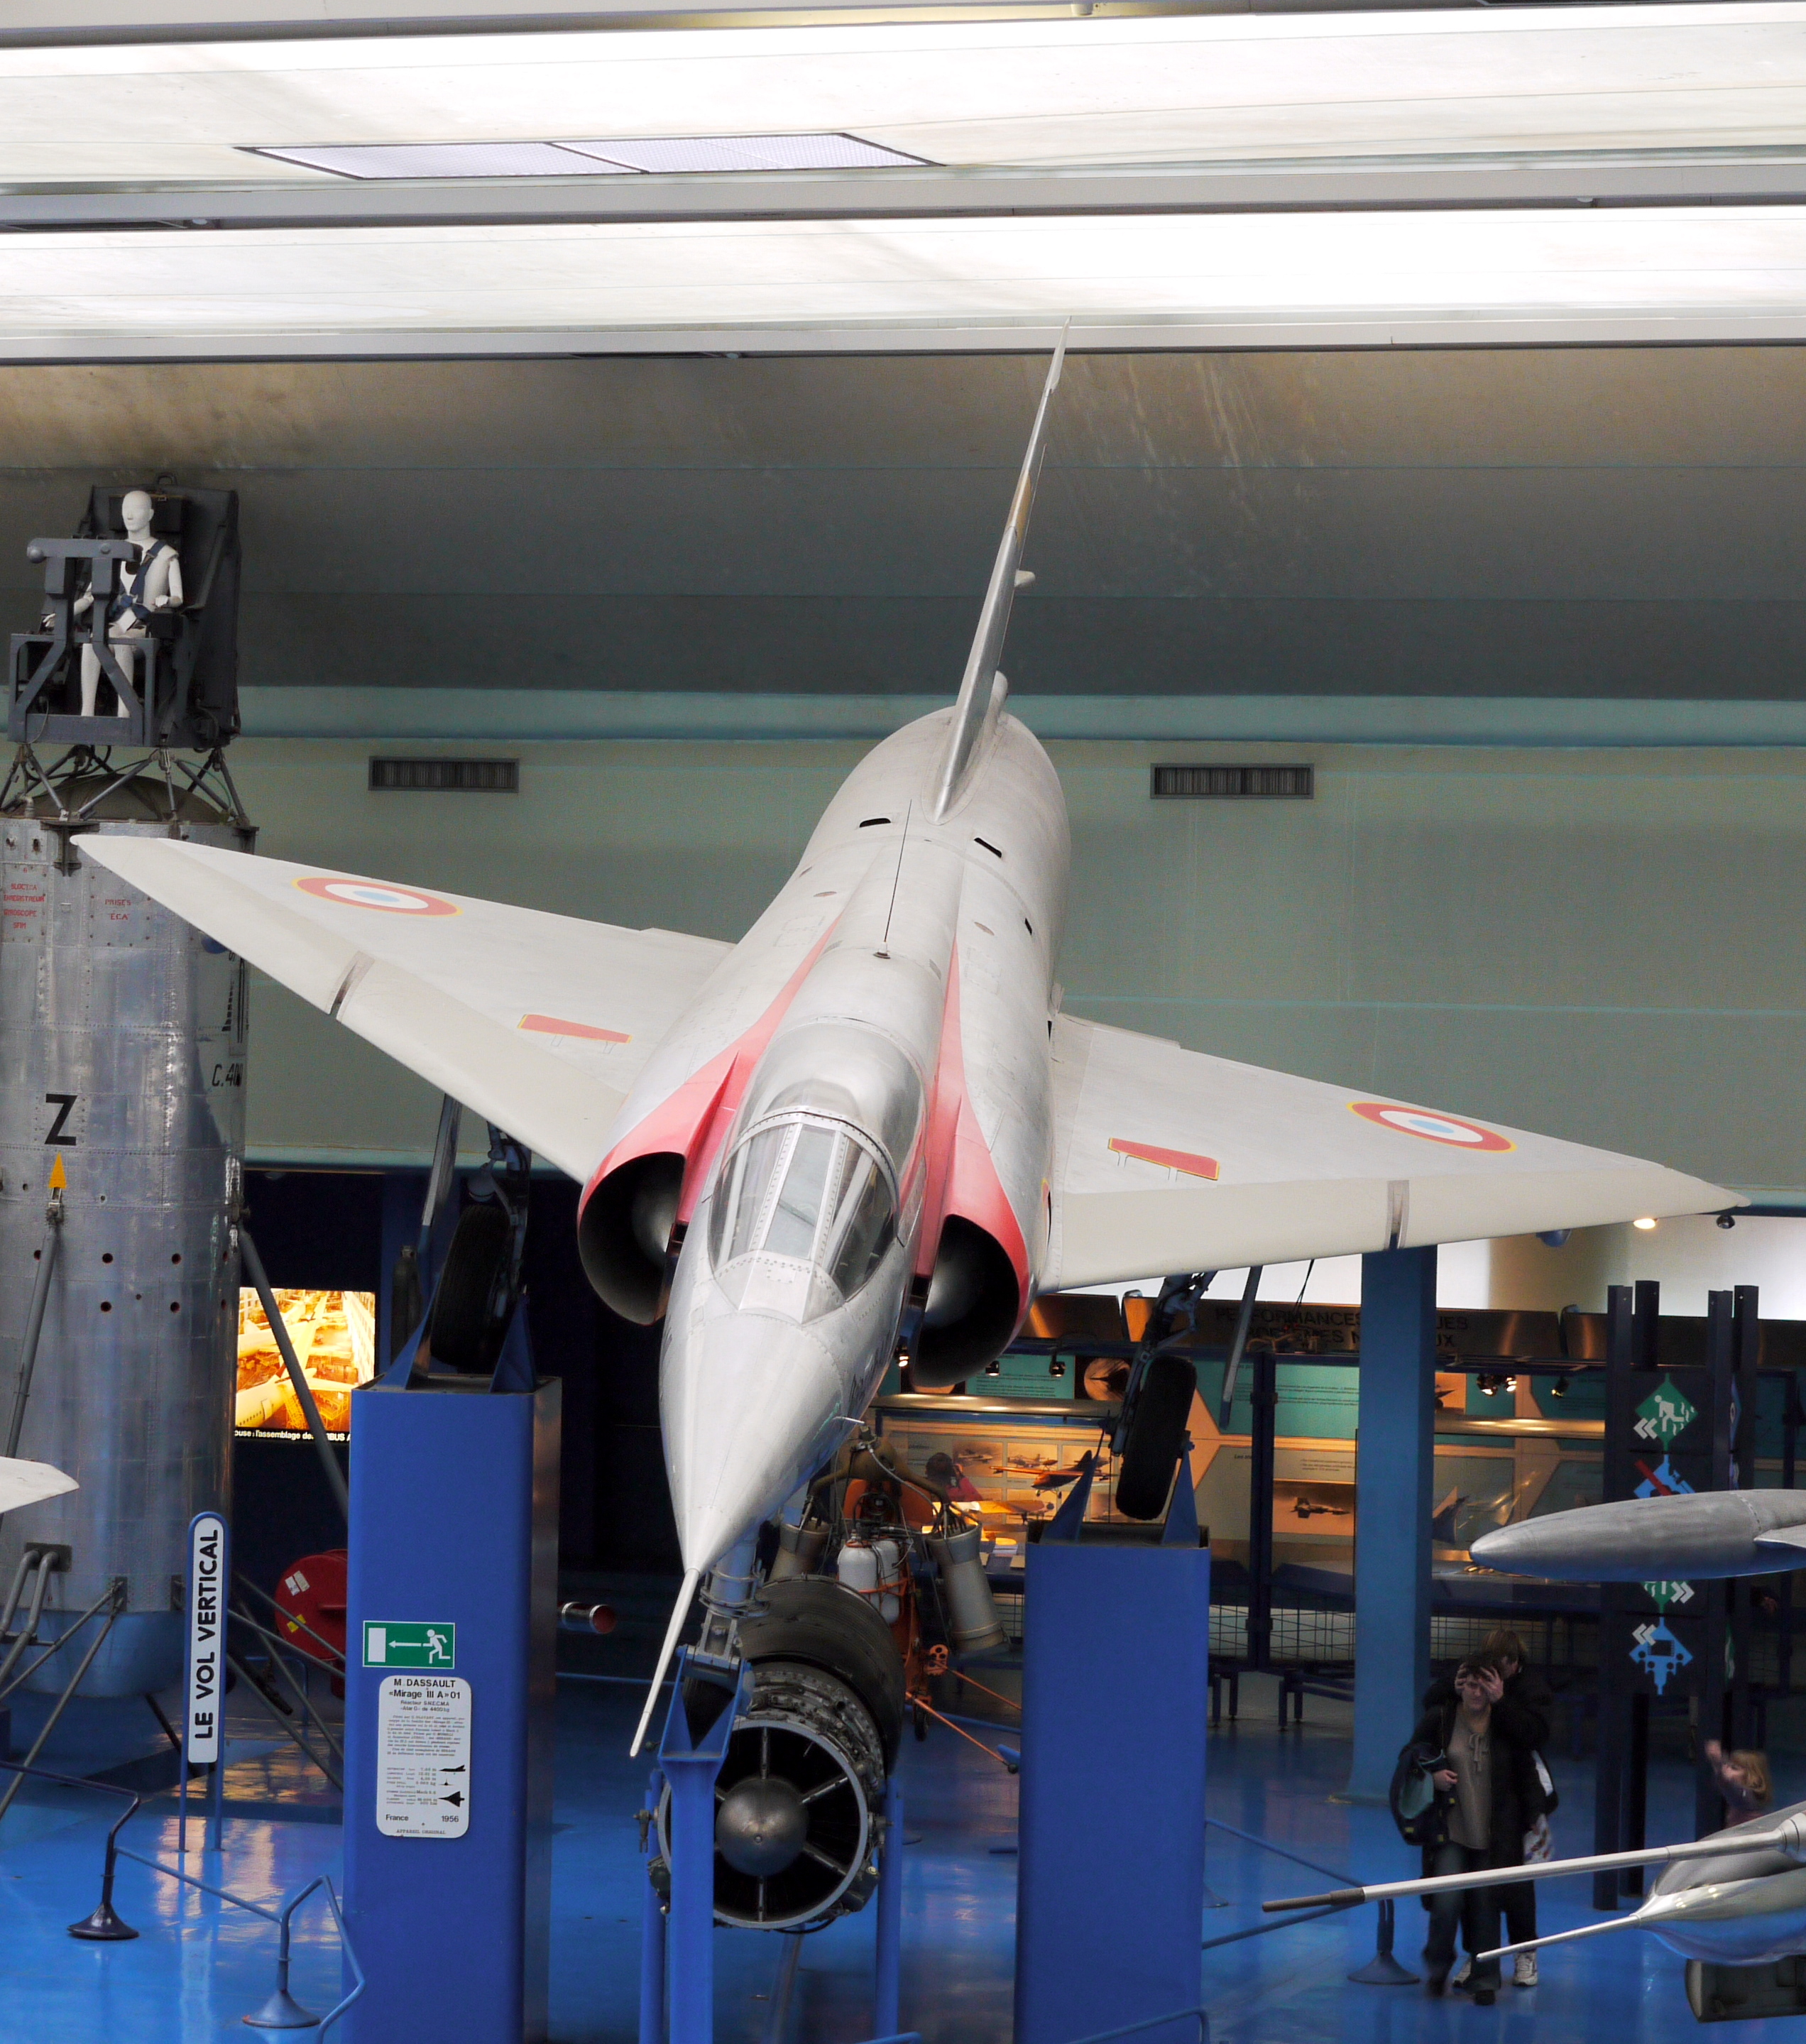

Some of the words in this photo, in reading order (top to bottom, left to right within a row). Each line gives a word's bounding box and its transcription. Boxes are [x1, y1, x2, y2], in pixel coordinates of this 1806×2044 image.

[44, 1093, 78, 1146] Z
[255, 1429, 301, 1441] l'assemblage
[198, 1529, 218, 1642] VERTICAL
[196, 1651, 215, 1700] VOL
[407, 1678, 456, 1688] DASSAULT
[195, 1712, 213, 1739] LE
